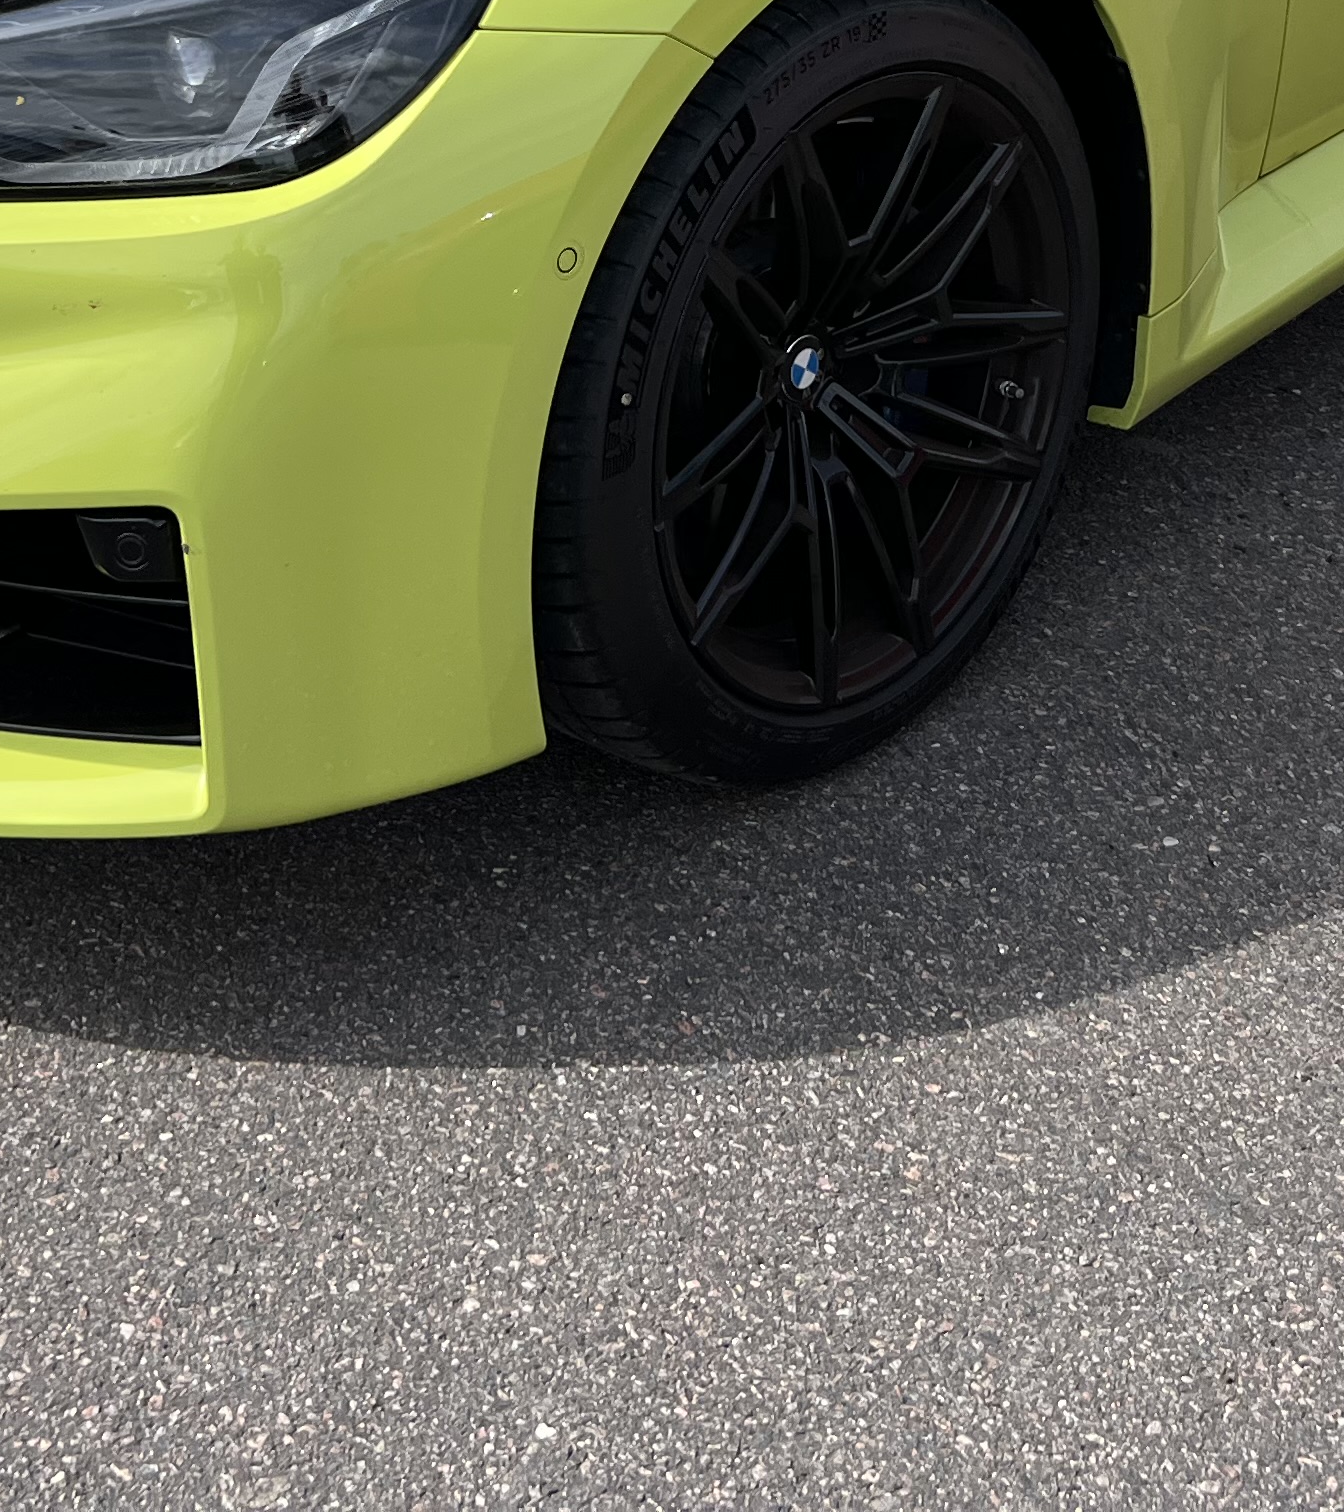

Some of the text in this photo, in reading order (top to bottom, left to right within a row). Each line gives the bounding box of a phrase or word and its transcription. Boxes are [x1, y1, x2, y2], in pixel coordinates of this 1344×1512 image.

[763, 50, 816, 104] 275/35
[821, 36, 840, 58] ZR
[847, 26, 861, 43] 19
[616, 119, 746, 394] MICHELIN
